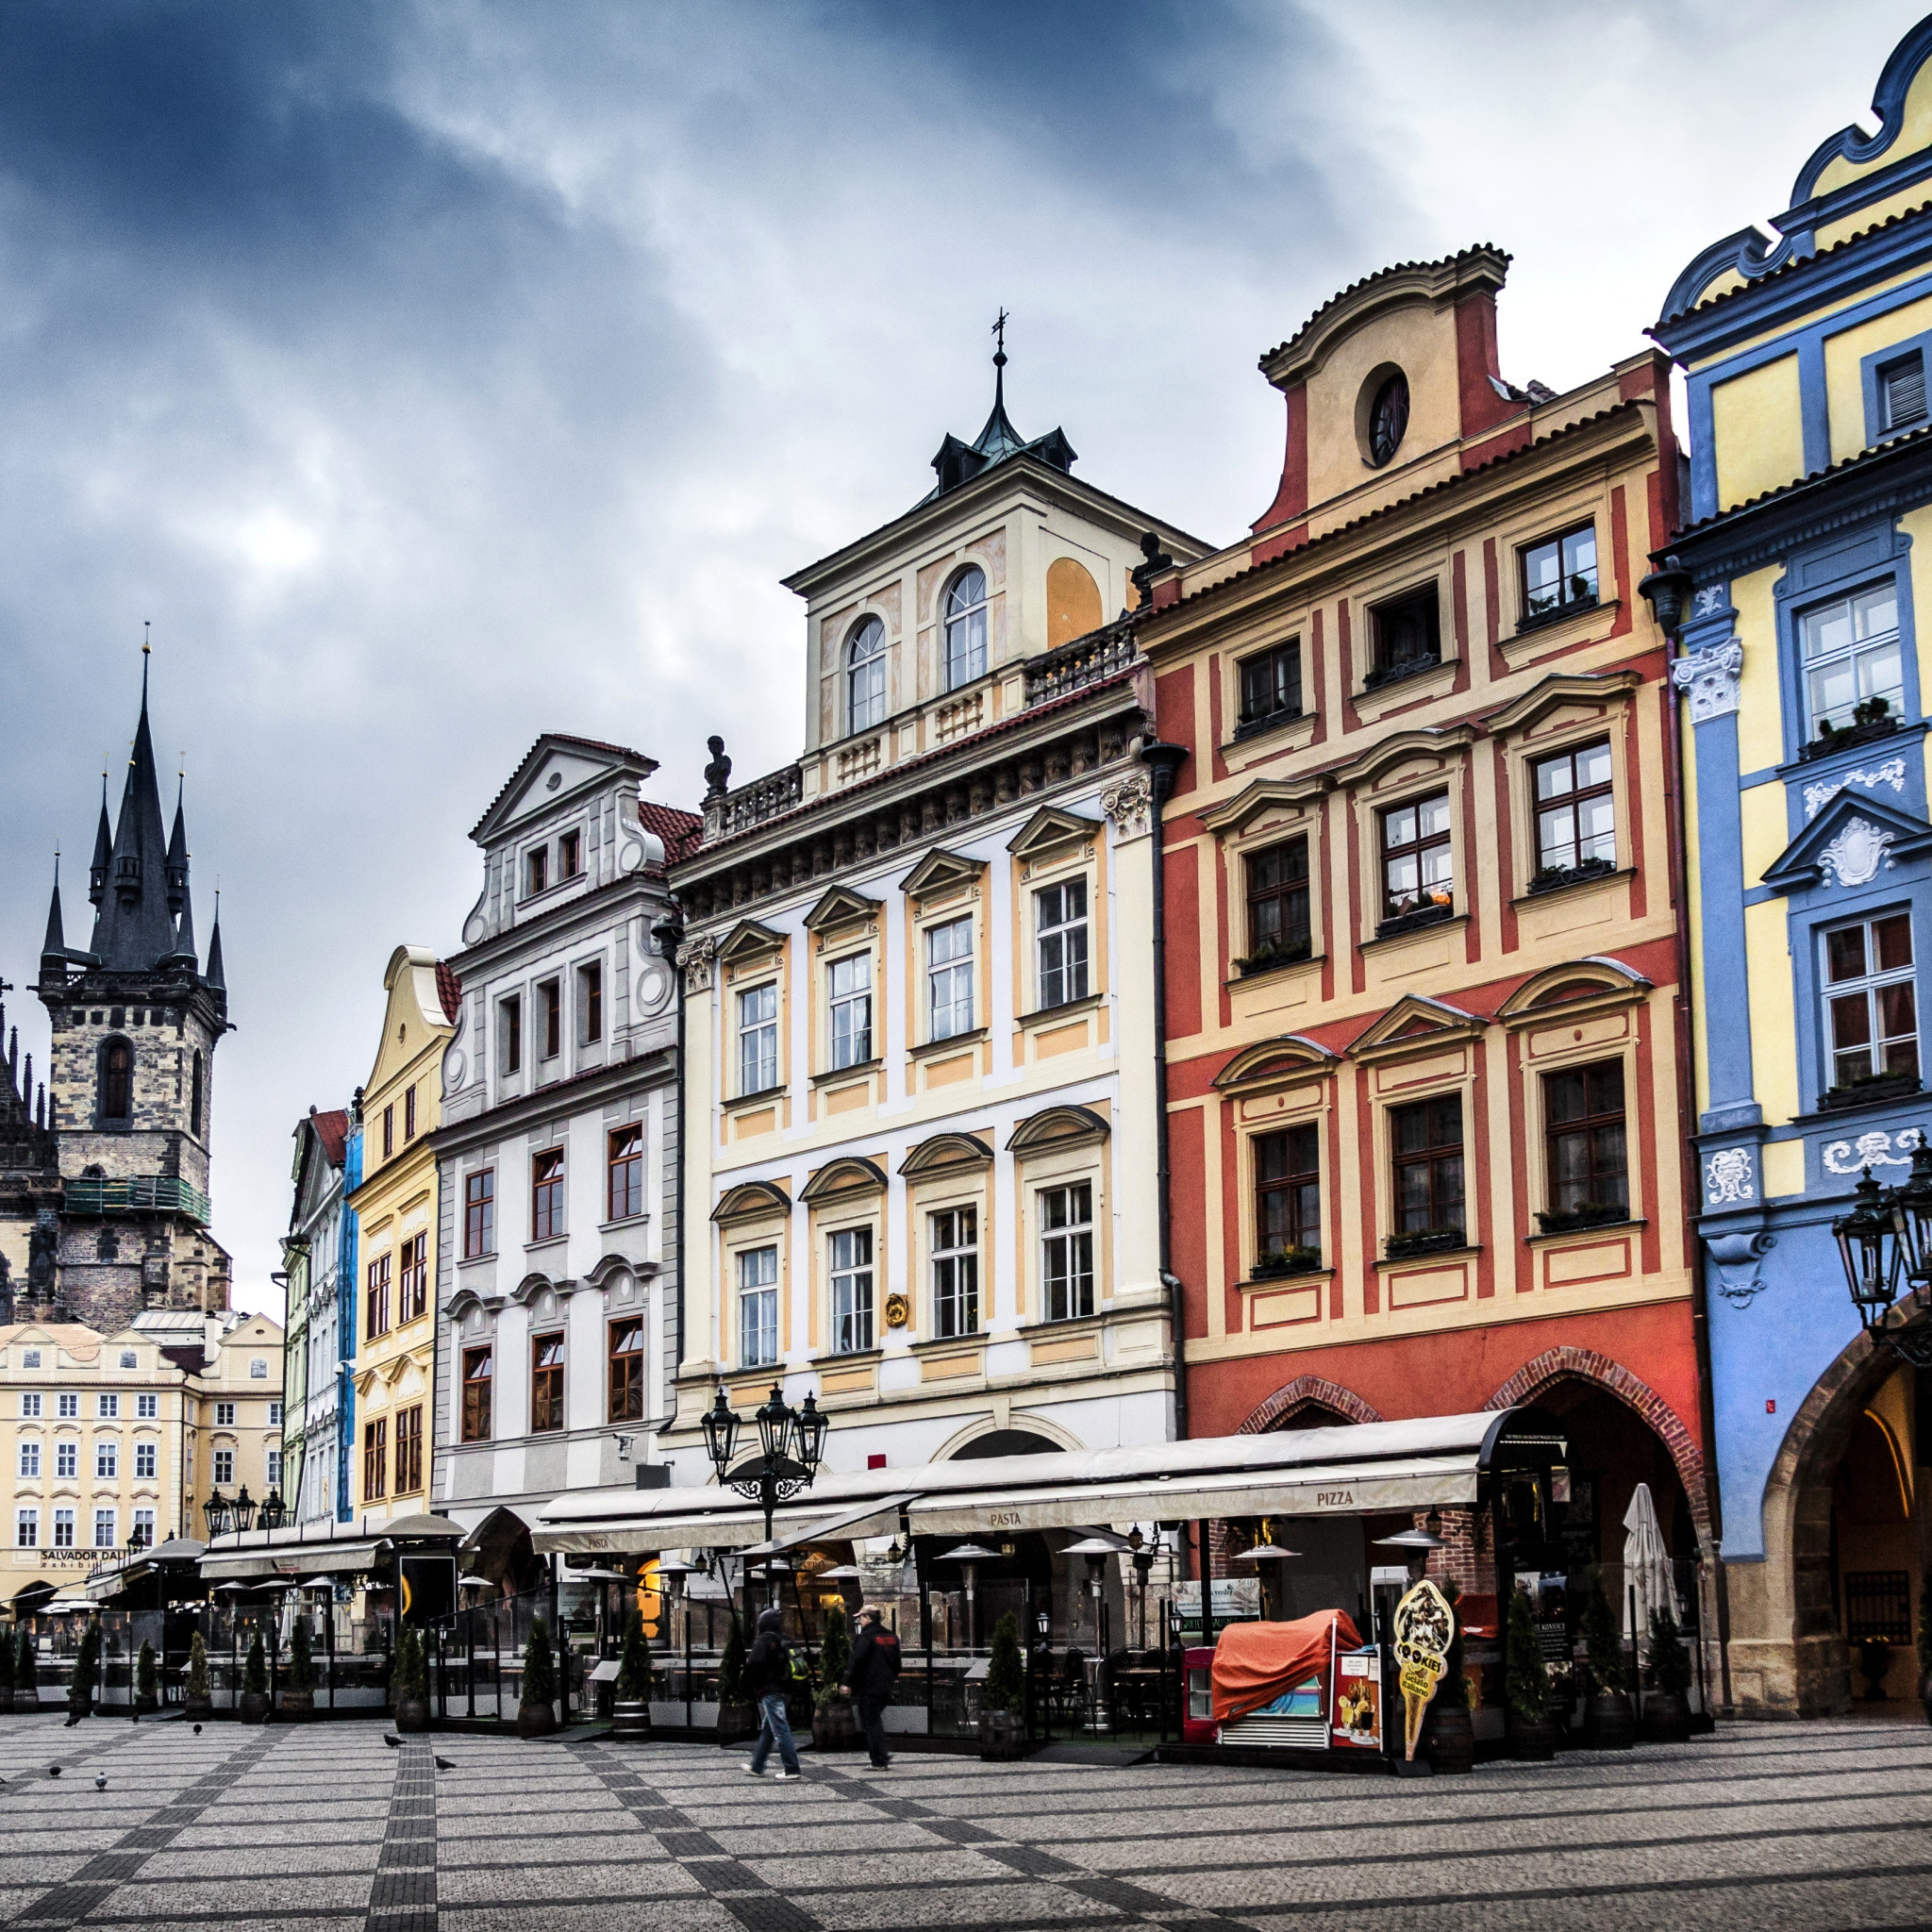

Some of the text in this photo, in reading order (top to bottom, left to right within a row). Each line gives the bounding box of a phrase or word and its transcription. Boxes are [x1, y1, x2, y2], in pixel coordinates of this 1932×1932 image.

[1317, 1491, 1354, 1506] PIZZA
[991, 1512, 1022, 1525] PASTA
[588, 1538, 609, 1548] PASTA
[42, 1551, 97, 1560] SALVADOR
[1397, 1643, 1441, 1674] COOKIES
[1406, 1672, 1428, 1689] Gelato
